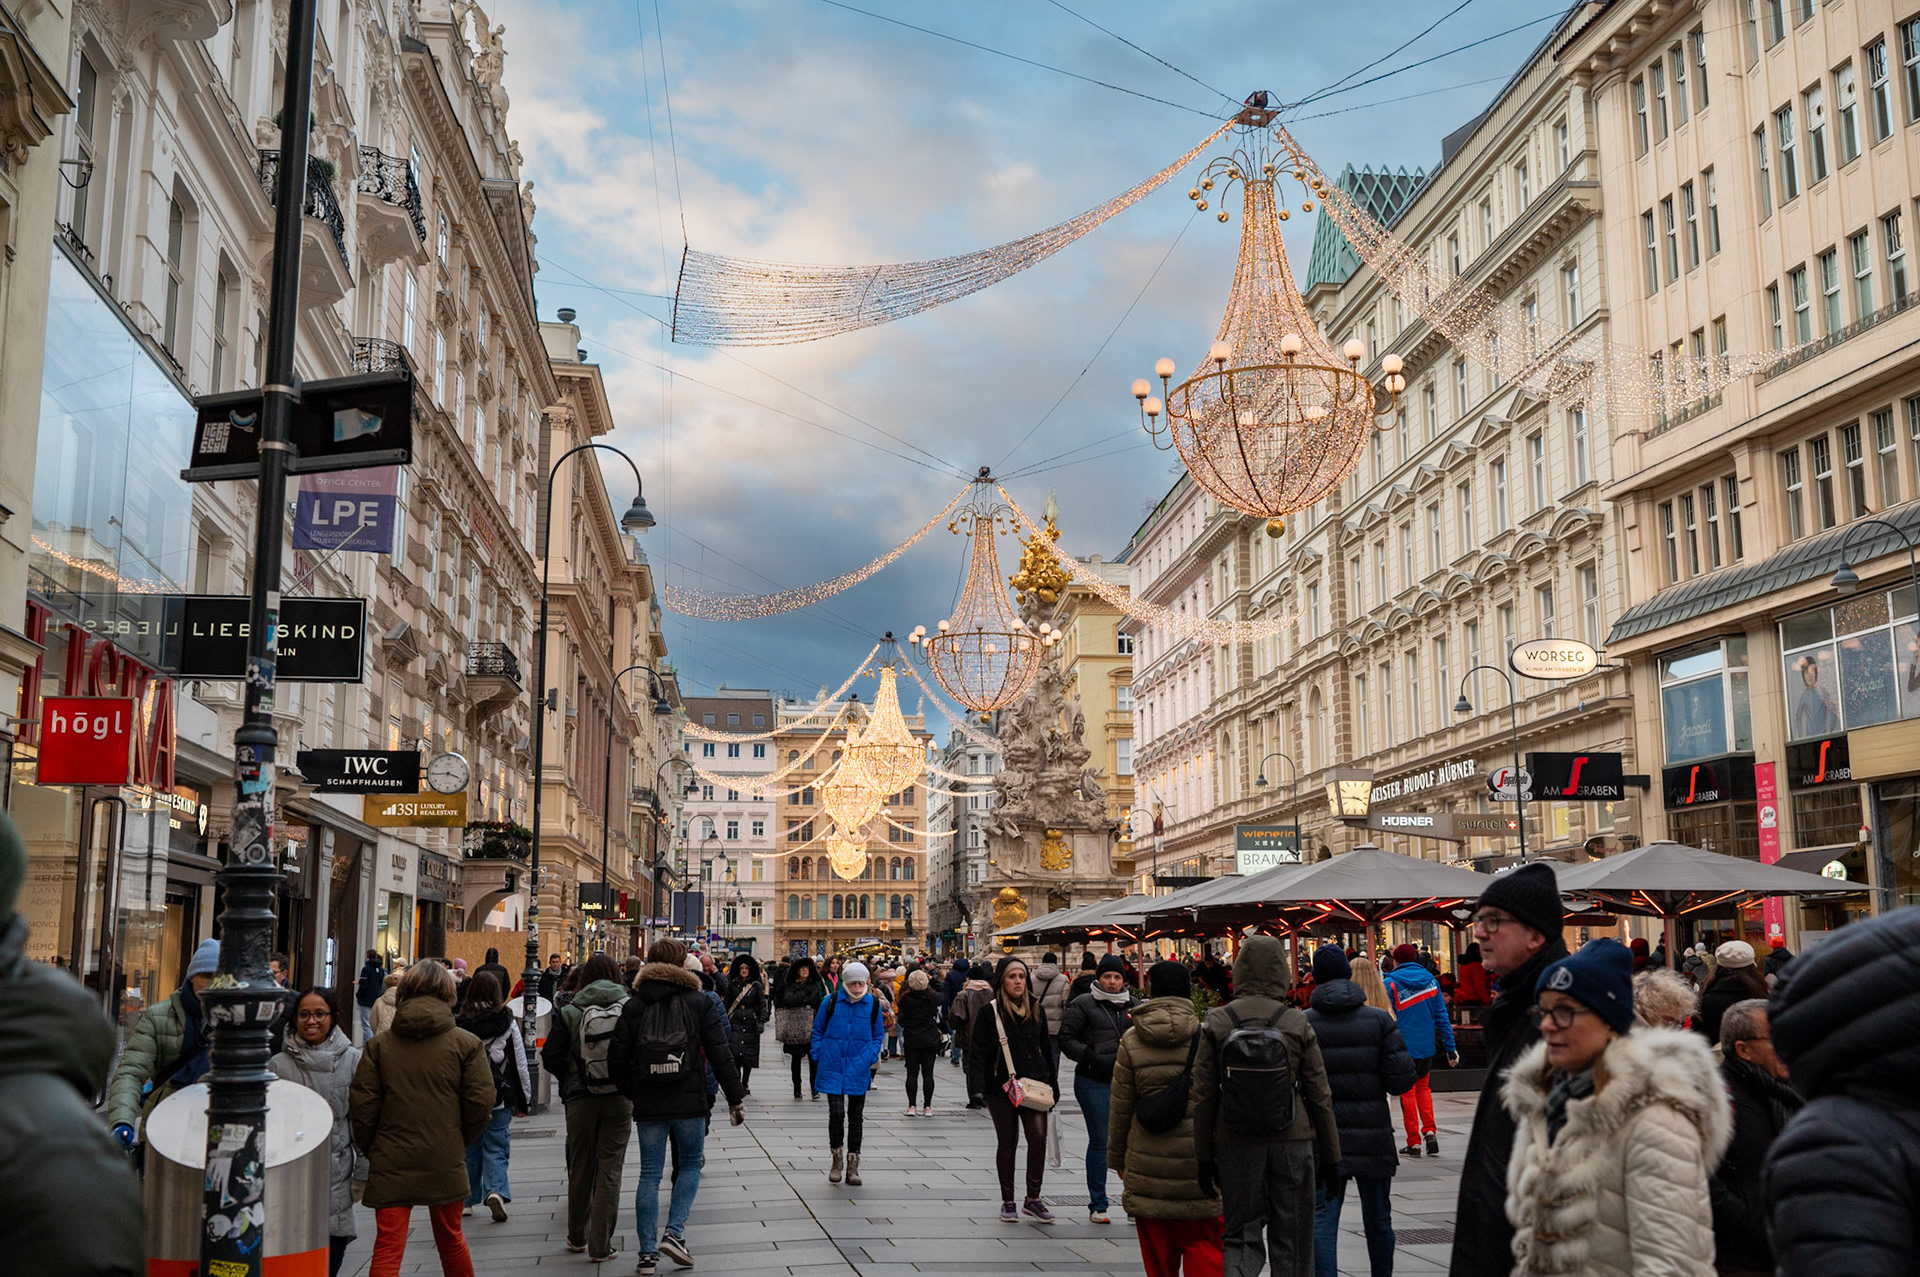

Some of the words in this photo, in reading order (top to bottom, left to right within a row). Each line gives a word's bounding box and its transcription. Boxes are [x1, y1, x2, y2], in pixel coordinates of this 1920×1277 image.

[316, 478, 346, 486] OFFICE
[348, 479, 381, 487] CENTER
[312, 500, 379, 527] LPE
[193, 622, 355, 639] LIEBSKIND
[276, 648, 296, 657] LIN
[1525, 650, 1585, 662] WORSEG
[51, 709, 123, 740] hōgl
[343, 756, 389, 775] IWC
[326, 778, 403, 787] SCHAFFHAUSEN
[1403, 770, 1435, 795] RUDOLF
[1438, 759, 1475, 783] HÜBNER
[1803, 774, 1815, 785] AM
[1543, 785, 1560, 796] AM
[1577, 785, 1618, 796] GRABEN
[1676, 795, 1687, 805] AM
[1694, 790, 1718, 802] GRABEN
[397, 803, 418, 816] 3SI
[1382, 816, 1433, 827] HÜBNER
[1458, 819, 1508, 831] swatch
[1242, 830, 1296, 838] wienerin
[650, 1062, 680, 1074] PUMA
